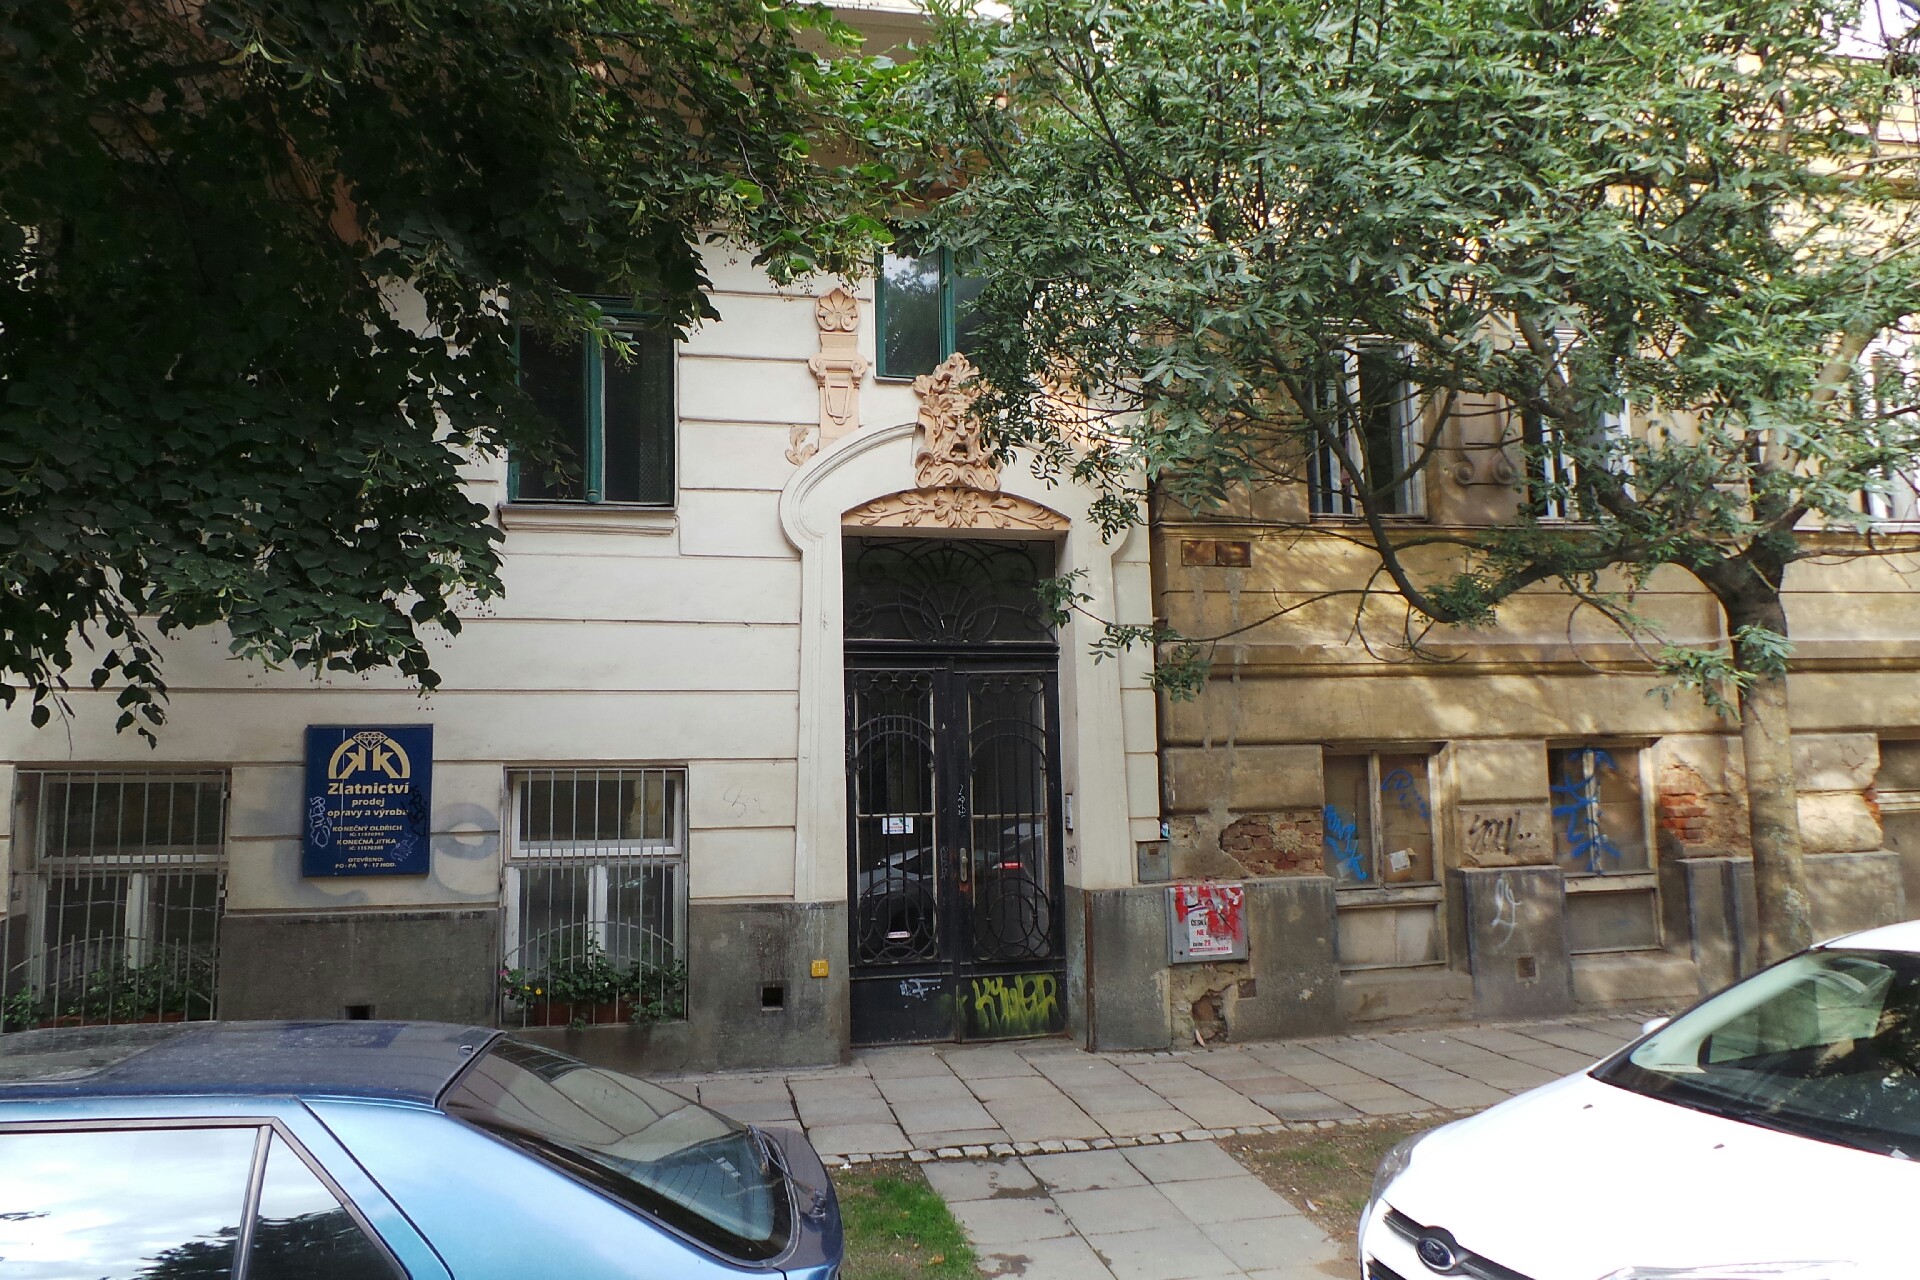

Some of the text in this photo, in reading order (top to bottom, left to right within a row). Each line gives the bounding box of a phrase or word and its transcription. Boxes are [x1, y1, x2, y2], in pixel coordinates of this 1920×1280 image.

[328, 782, 409, 794] Zlatnictví
[352, 798, 385, 807] prodej
[327, 810, 363, 819] opravy
[332, 824, 368, 832] KONEČNÝ
